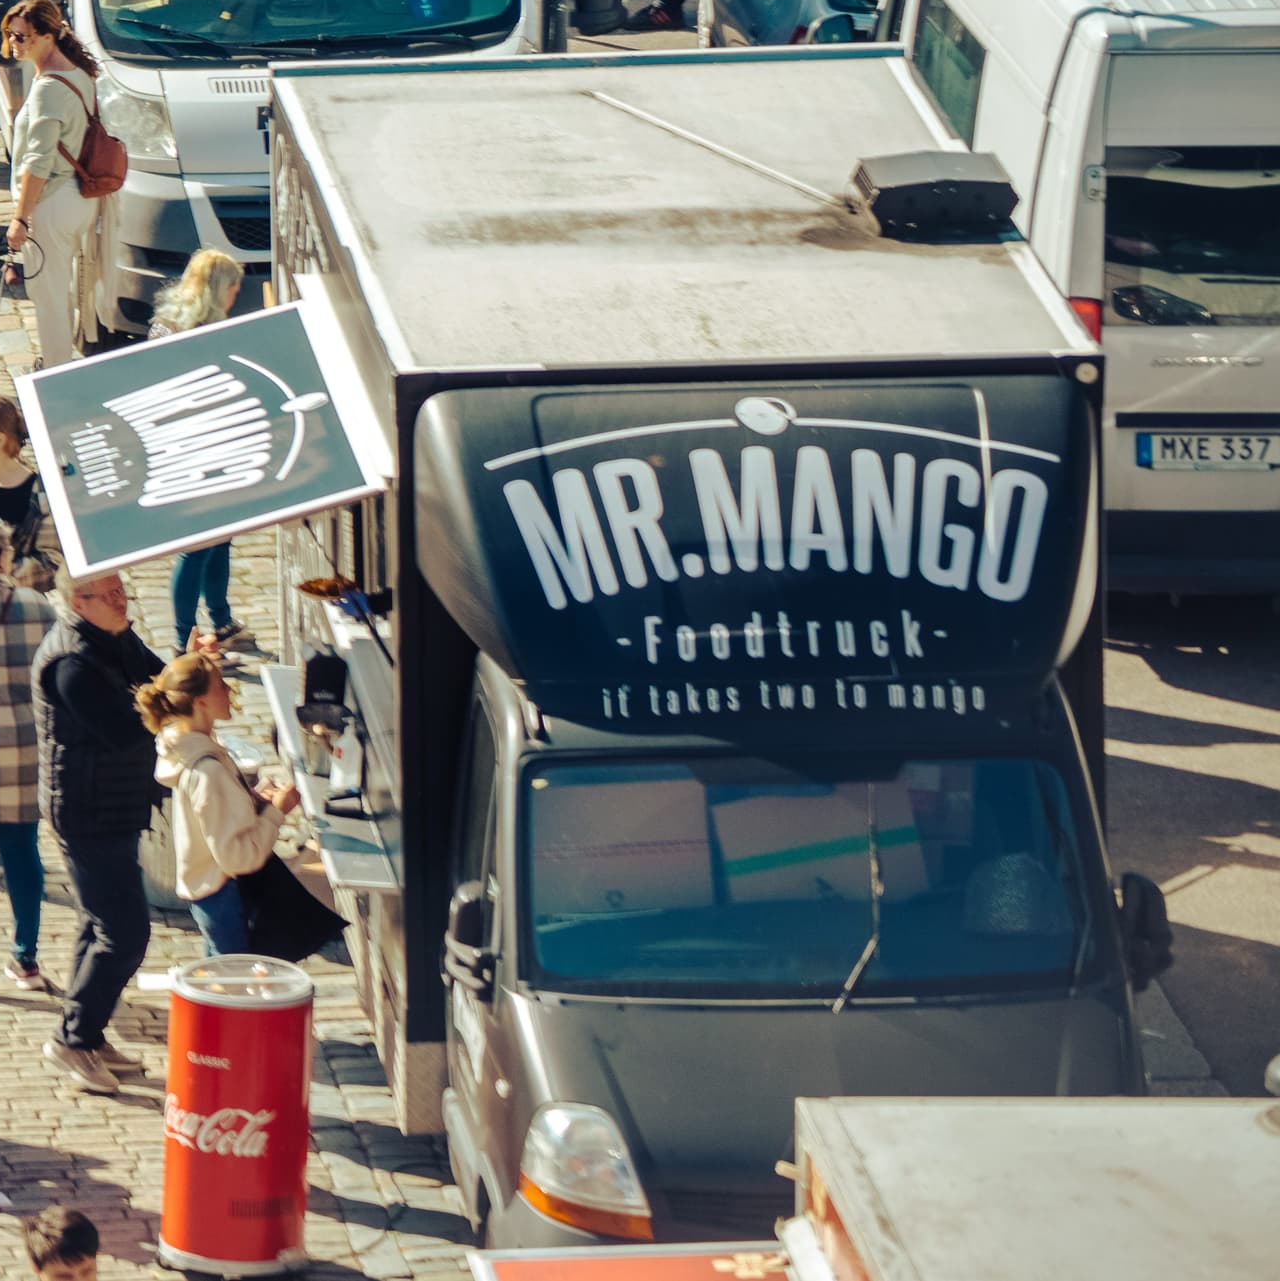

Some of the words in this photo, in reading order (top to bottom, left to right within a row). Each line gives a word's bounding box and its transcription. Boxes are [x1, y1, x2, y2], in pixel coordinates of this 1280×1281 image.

[102, 364, 273, 507] MR.MANGO
[1161, 437, 1210, 461] MXE
[1221, 437, 1271, 461] 337
[503, 445, 1049, 610] MR.MANGO
[602, 684, 631, 718] it
[649, 679, 740, 715] takes
[759, 678, 816, 710] two
[835, 678, 868, 709] to
[887, 680, 986, 715] mango
